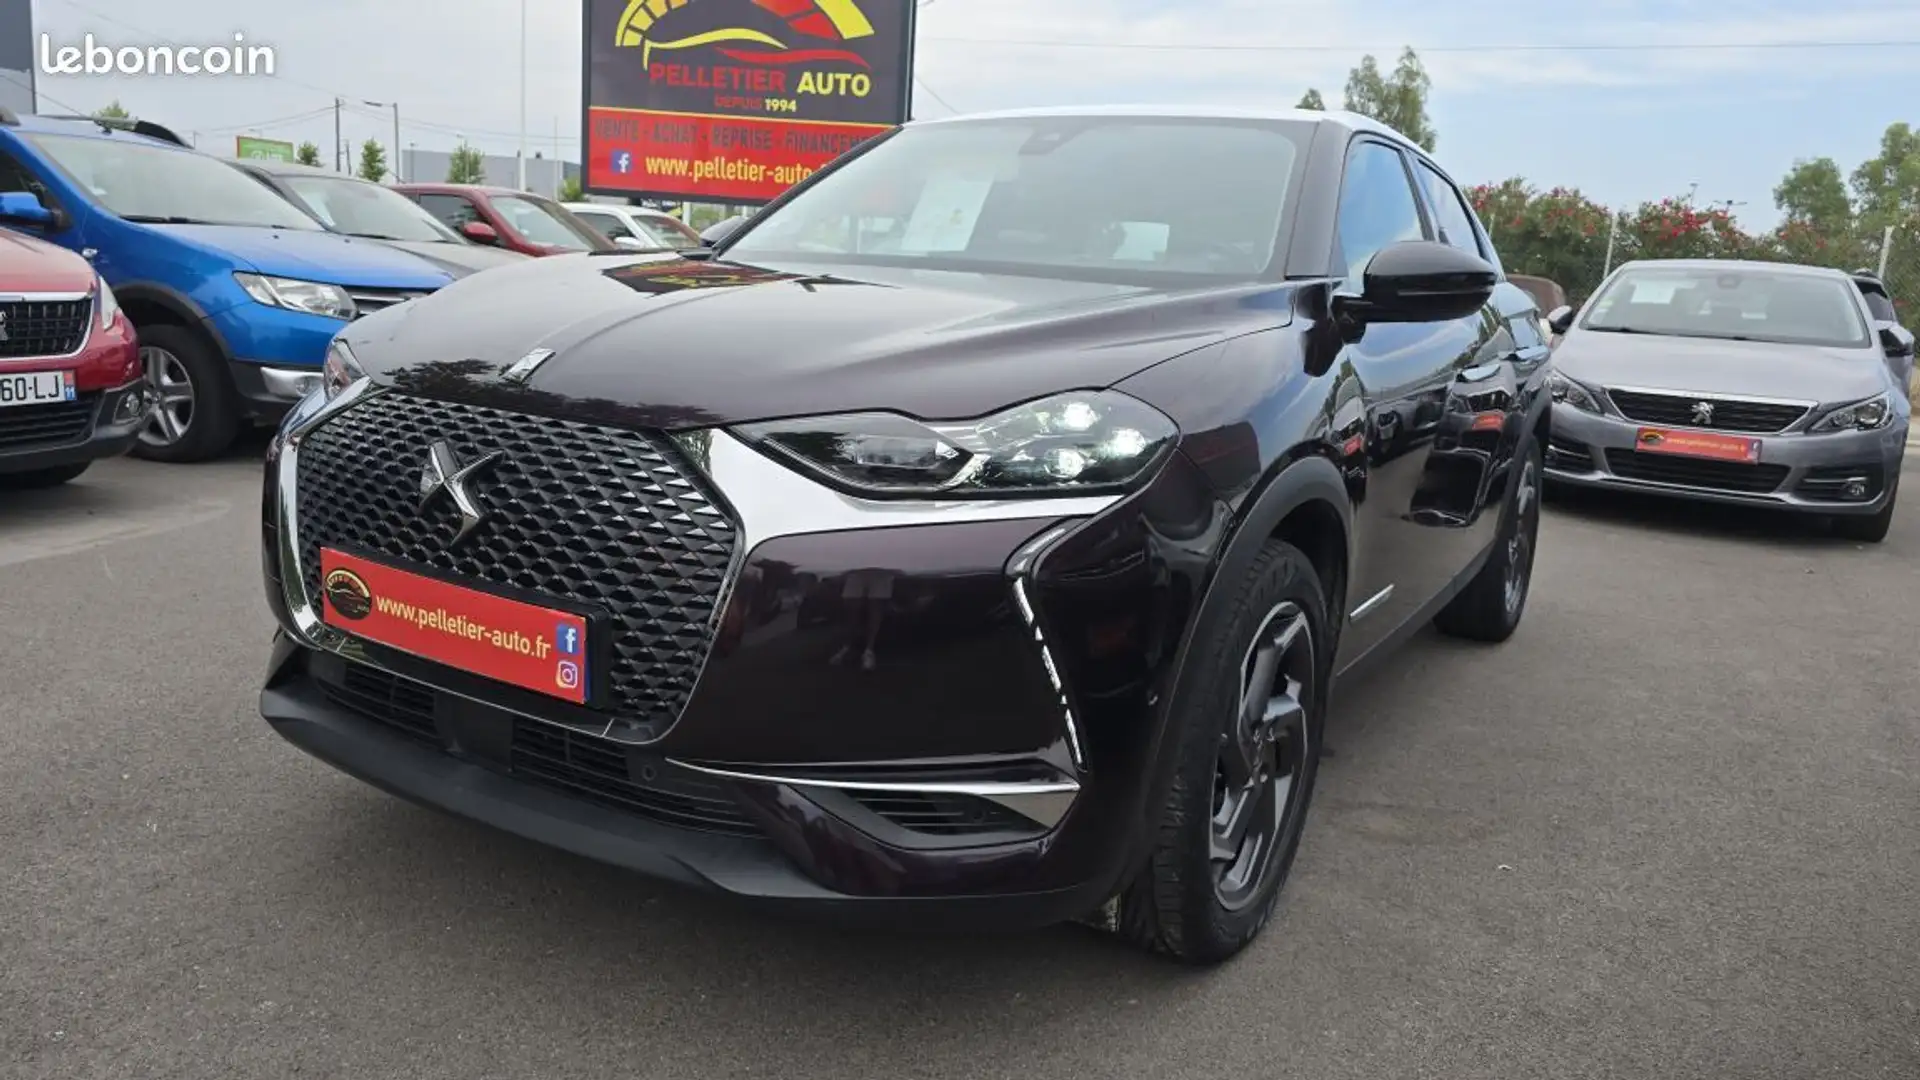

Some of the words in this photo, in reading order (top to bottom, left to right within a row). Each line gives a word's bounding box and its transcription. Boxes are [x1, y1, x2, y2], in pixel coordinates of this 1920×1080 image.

[650, 63, 786, 93] PELLETIER
[797, 72, 871, 97] AUTO
[715, 94, 762, 108] DEPUIS
[765, 98, 797, 112] 1994
[594, 117, 639, 142] VENTE
[653, 122, 697, 143] ACHAT
[712, 126, 772, 150] REPRISE
[376, 594, 551, 660] www.pelletier-auto.fr
